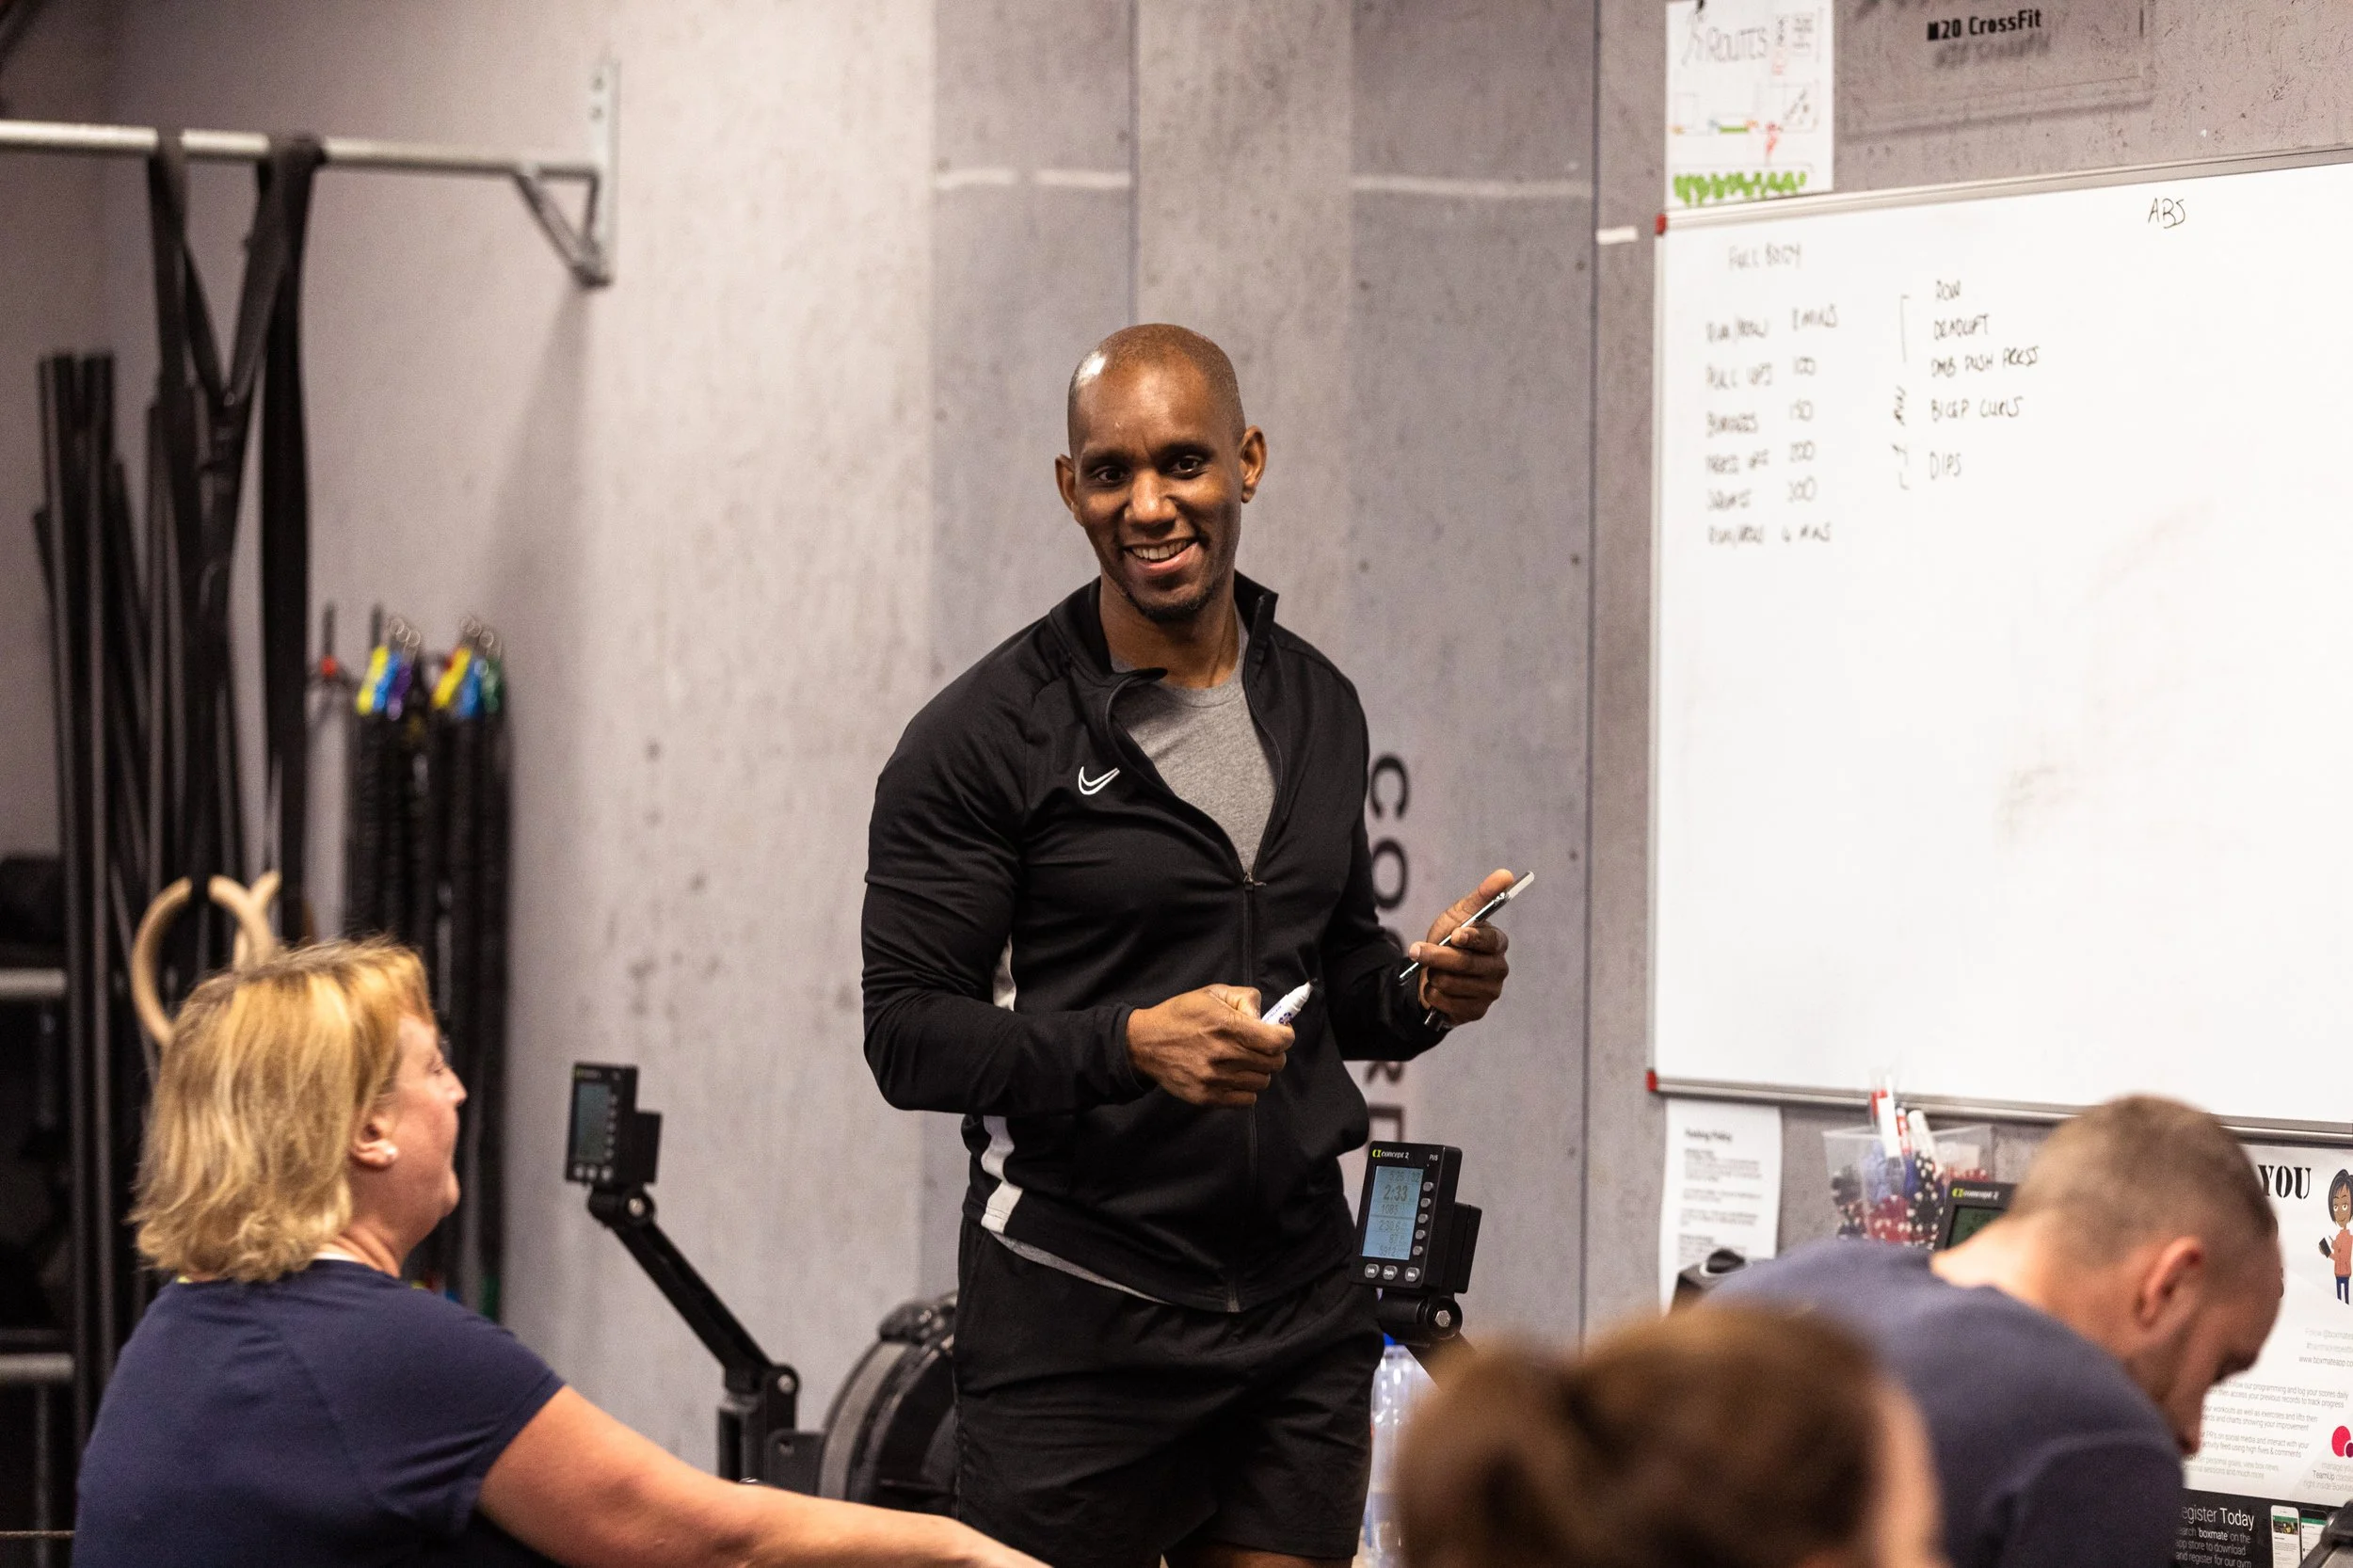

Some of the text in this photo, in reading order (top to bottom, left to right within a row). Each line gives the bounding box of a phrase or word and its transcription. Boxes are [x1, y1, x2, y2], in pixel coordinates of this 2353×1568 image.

[1969, 8, 2041, 36] CrossFit
[2148, 197, 2186, 230] ABS
[1935, 279, 1961, 302] ROW
[1933, 312, 1990, 341] DEADLIFT
[1930, 395, 2024, 423] BICEP CURLS
[1929, 451, 1961, 480] DIPS
[2258, 1164, 2312, 1200] YOU
[1383, 1184, 1408, 1202] 2:33
[2248, 1392, 2259, 1400] your
[2260, 1393, 2281, 1402] previous
[2281, 1395, 2300, 1404] records
[2308, 1398, 2320, 1406] track
[2321, 1400, 2345, 1410] progress
[2253, 1384, 2285, 1395] programming
[2287, 1385, 2297, 1394] and
[2306, 1388, 2317, 1398] your
[2336, 1391, 2348, 1400] daily
[2244, 1408, 2255, 1416] well
[2243, 1417, 2264, 1429] showing
[2264, 1420, 2275, 1429] your
[2276, 1421, 2309, 1432] improvement
[2232, 1443, 2245, 1453] using
[2246, 1444, 2257, 1455] high
[2274, 1448, 2302, 1458] comments
[2256, 1435, 2265, 1444] and
[2266, 1436, 2285, 1446] interact
[2286, 1438, 2297, 1447] with
[2297, 1440, 2310, 1449] your
[2313, 1469, 2334, 1480] TeamUp
[2181, 1504, 2255, 1531] egister Today
[2230, 1533, 2239, 1542] on
[2239, 1533, 2251, 1544] the
[2187, 1540, 2205, 1551] store
[2205, 1542, 2214, 1552] to
[2214, 1543, 2247, 1556] download
[2188, 1552, 2213, 1565] register
[2214, 1554, 2224, 1566] for
[2224, 1557, 2236, 1567] our
